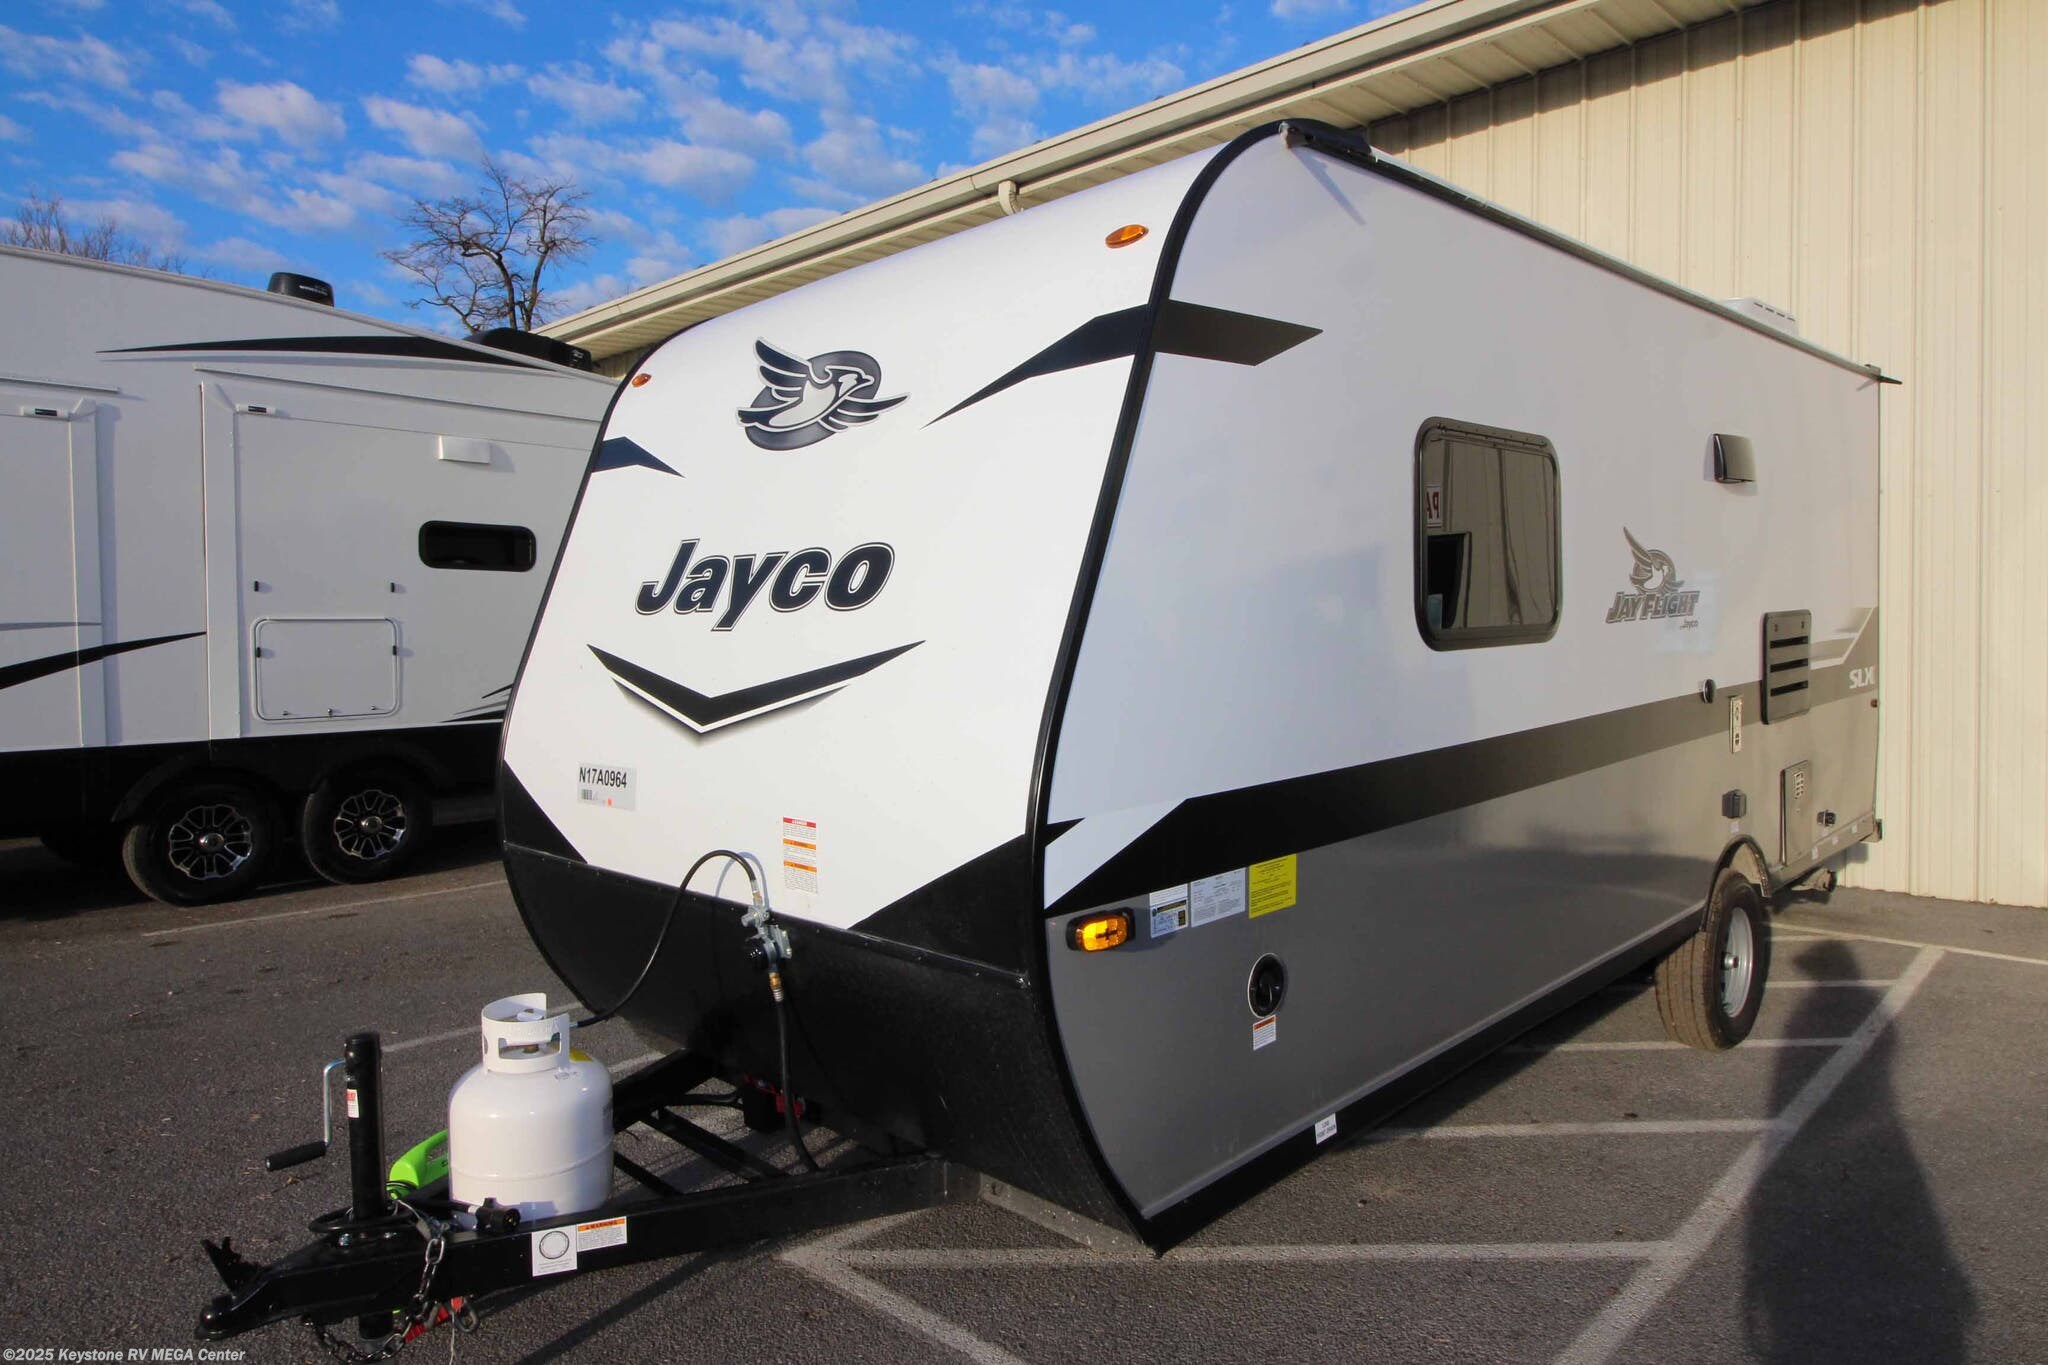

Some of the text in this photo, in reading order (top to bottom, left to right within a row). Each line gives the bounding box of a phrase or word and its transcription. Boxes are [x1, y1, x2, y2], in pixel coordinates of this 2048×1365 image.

[634, 537, 896, 632] Jayco
[1605, 590, 1701, 624] JAY FLIGHT
[1849, 665, 1875, 689] SLX
[578, 766, 628, 789] N17A0964
